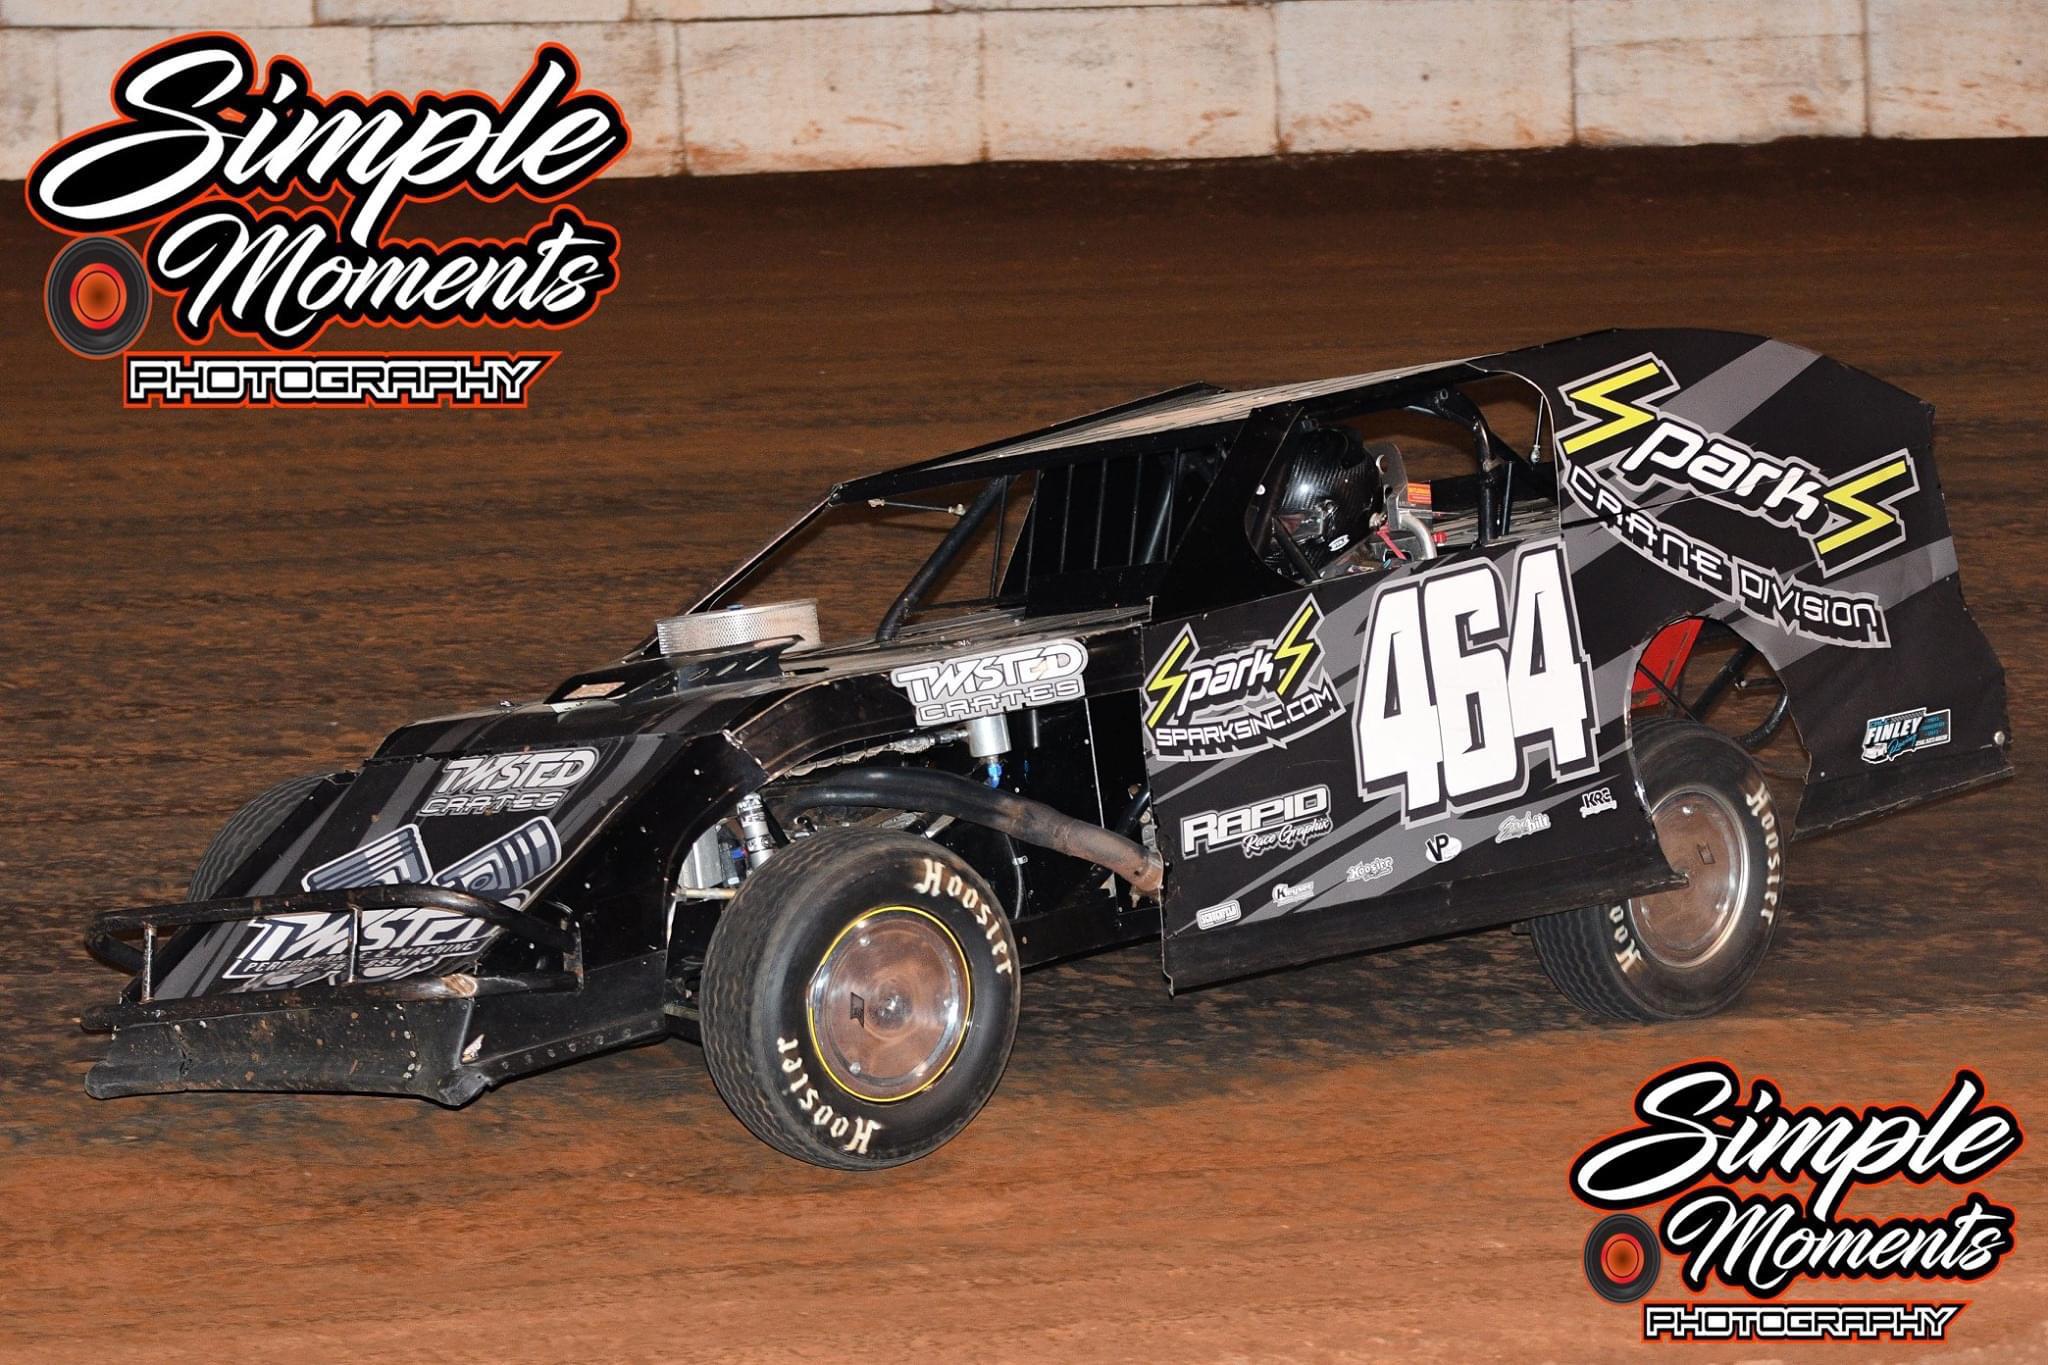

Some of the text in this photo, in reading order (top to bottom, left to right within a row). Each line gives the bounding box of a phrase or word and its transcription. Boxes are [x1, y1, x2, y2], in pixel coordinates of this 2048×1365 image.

[1569, 465, 1879, 629] CRANE DIVISION
[898, 644, 1083, 702] TWISTED
[919, 680, 1081, 722] CRATES
[1358, 548, 1588, 811] 464
[1155, 686, 1334, 747] SPARKSINC.COM
[1864, 716, 1924, 745] FINLEY
[437, 749, 597, 794] TWISTED
[1584, 788, 1611, 810] KRC
[421, 791, 563, 814] CRATES
[1183, 787, 1327, 853] RAPID
[1426, 834, 1450, 862] VP
[1745, 782, 1781, 926] Hoosier
[913, 858, 1013, 976] Hoosier
[243, 950, 373, 974] PERFORMANE
[394, 941, 476, 957] MACHINE
[776, 1036, 881, 1155] Hoosier
